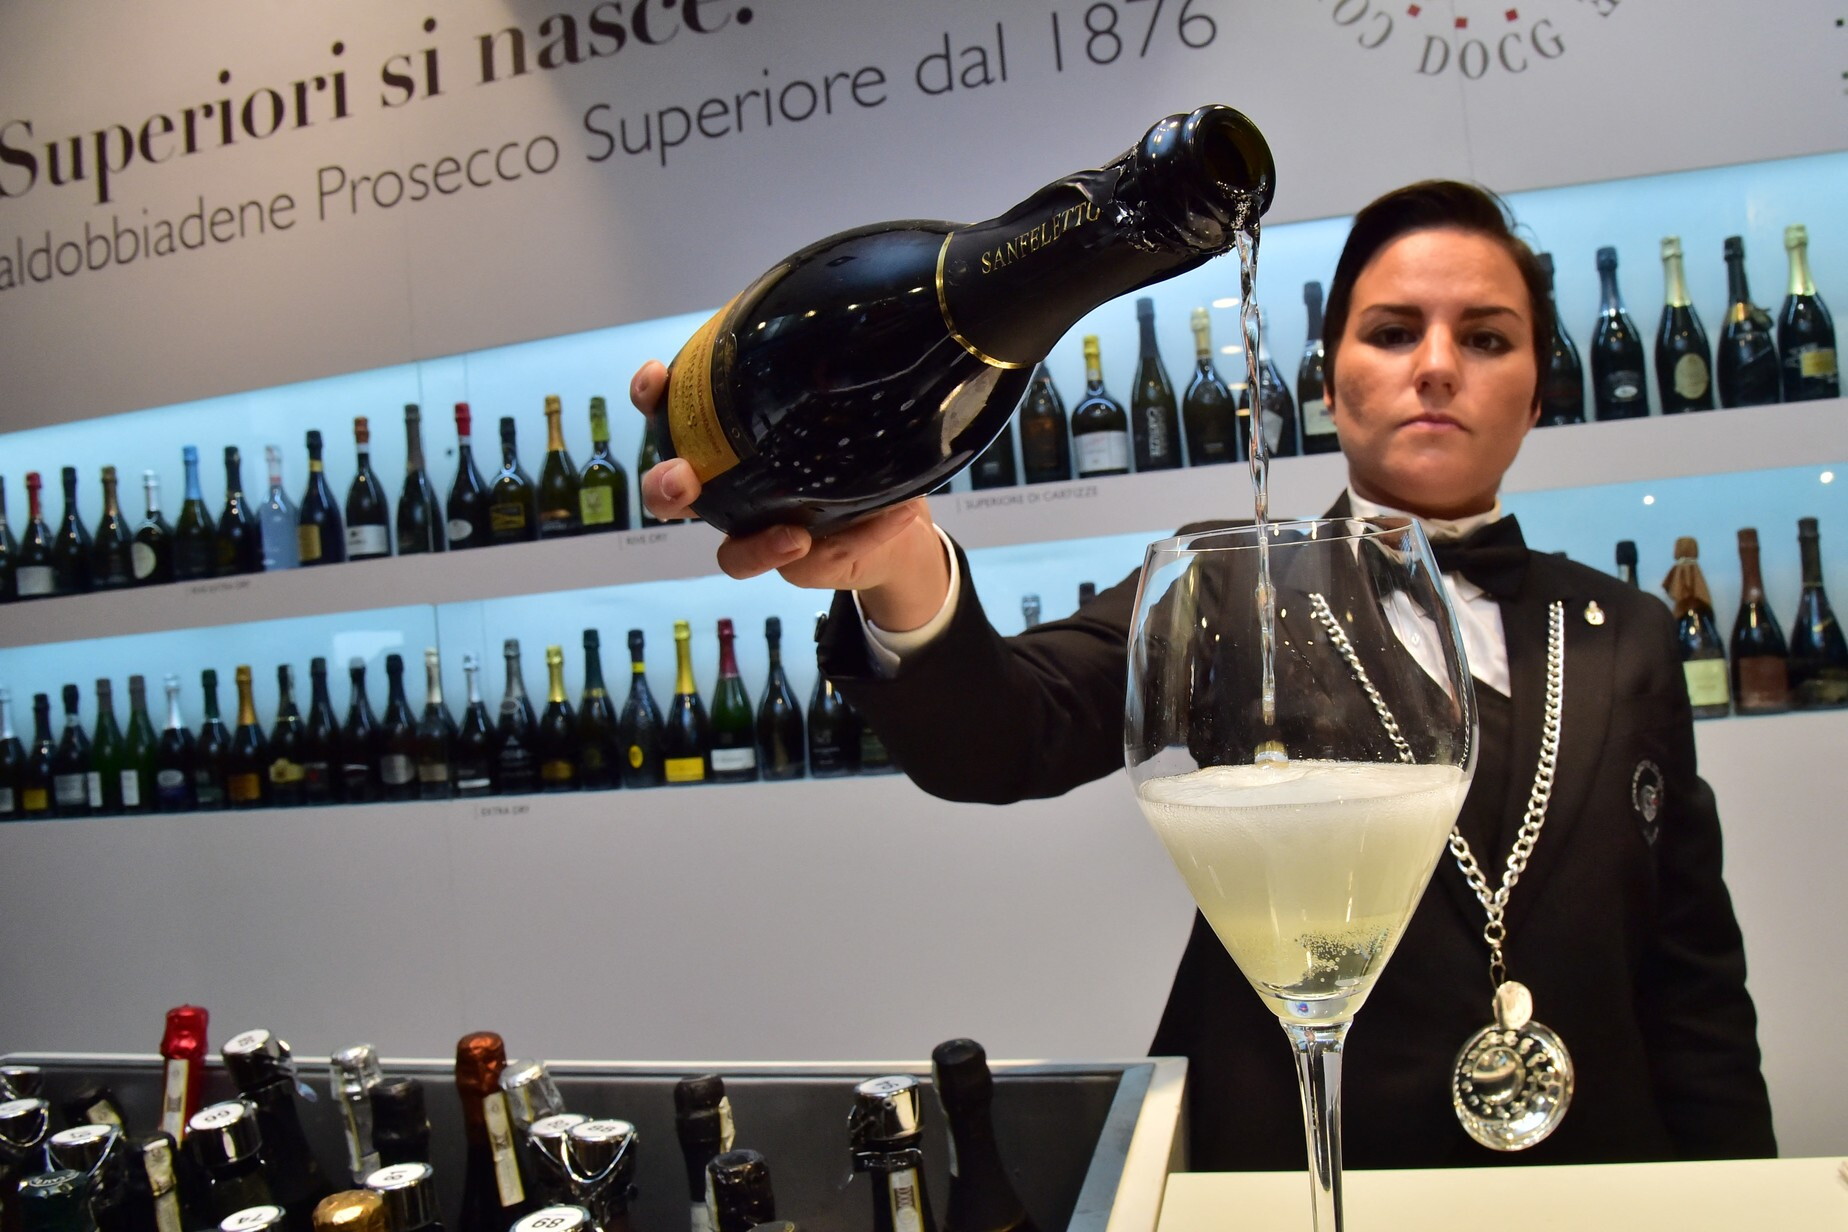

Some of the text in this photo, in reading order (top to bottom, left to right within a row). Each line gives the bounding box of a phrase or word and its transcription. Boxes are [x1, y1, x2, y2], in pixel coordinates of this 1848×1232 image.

[0, 41, 351, 206] Superiori
[378, 17, 443, 109] si
[317, 134, 560, 221] Prosecco
[583, 67, 888, 168] Superiore
[915, 22, 1008, 96] dal
[1051, 0, 1217, 72] 1876
[1416, 18, 1566, 80] DOCG
[981, 201, 1101, 274] SANFELETTO
